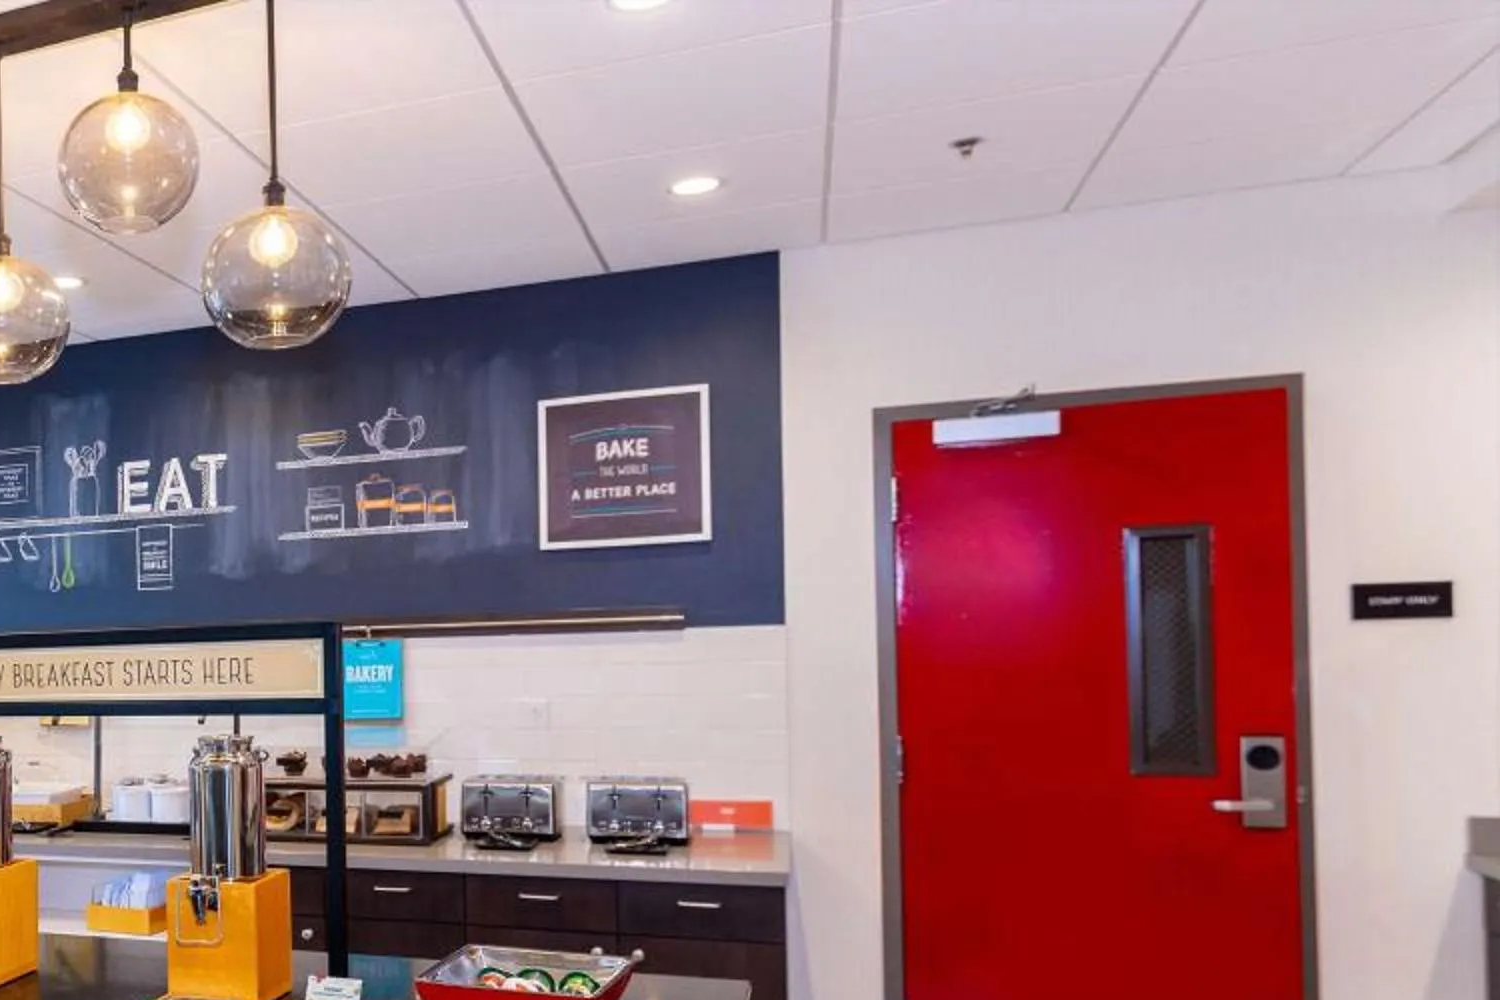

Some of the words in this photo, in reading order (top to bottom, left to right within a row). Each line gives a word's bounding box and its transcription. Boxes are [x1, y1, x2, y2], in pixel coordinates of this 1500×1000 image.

[596, 438, 649, 461] BAKE
[118, 453, 227, 514] EAT
[571, 489, 581, 501] A
[584, 485, 632, 499] BETTER
[635, 482, 676, 496] PLACE
[13, 661, 115, 688] BREAKFAST
[123, 659, 193, 686] STARTS
[202, 657, 254, 685] HERE
[345, 663, 394, 683] BAKERY
